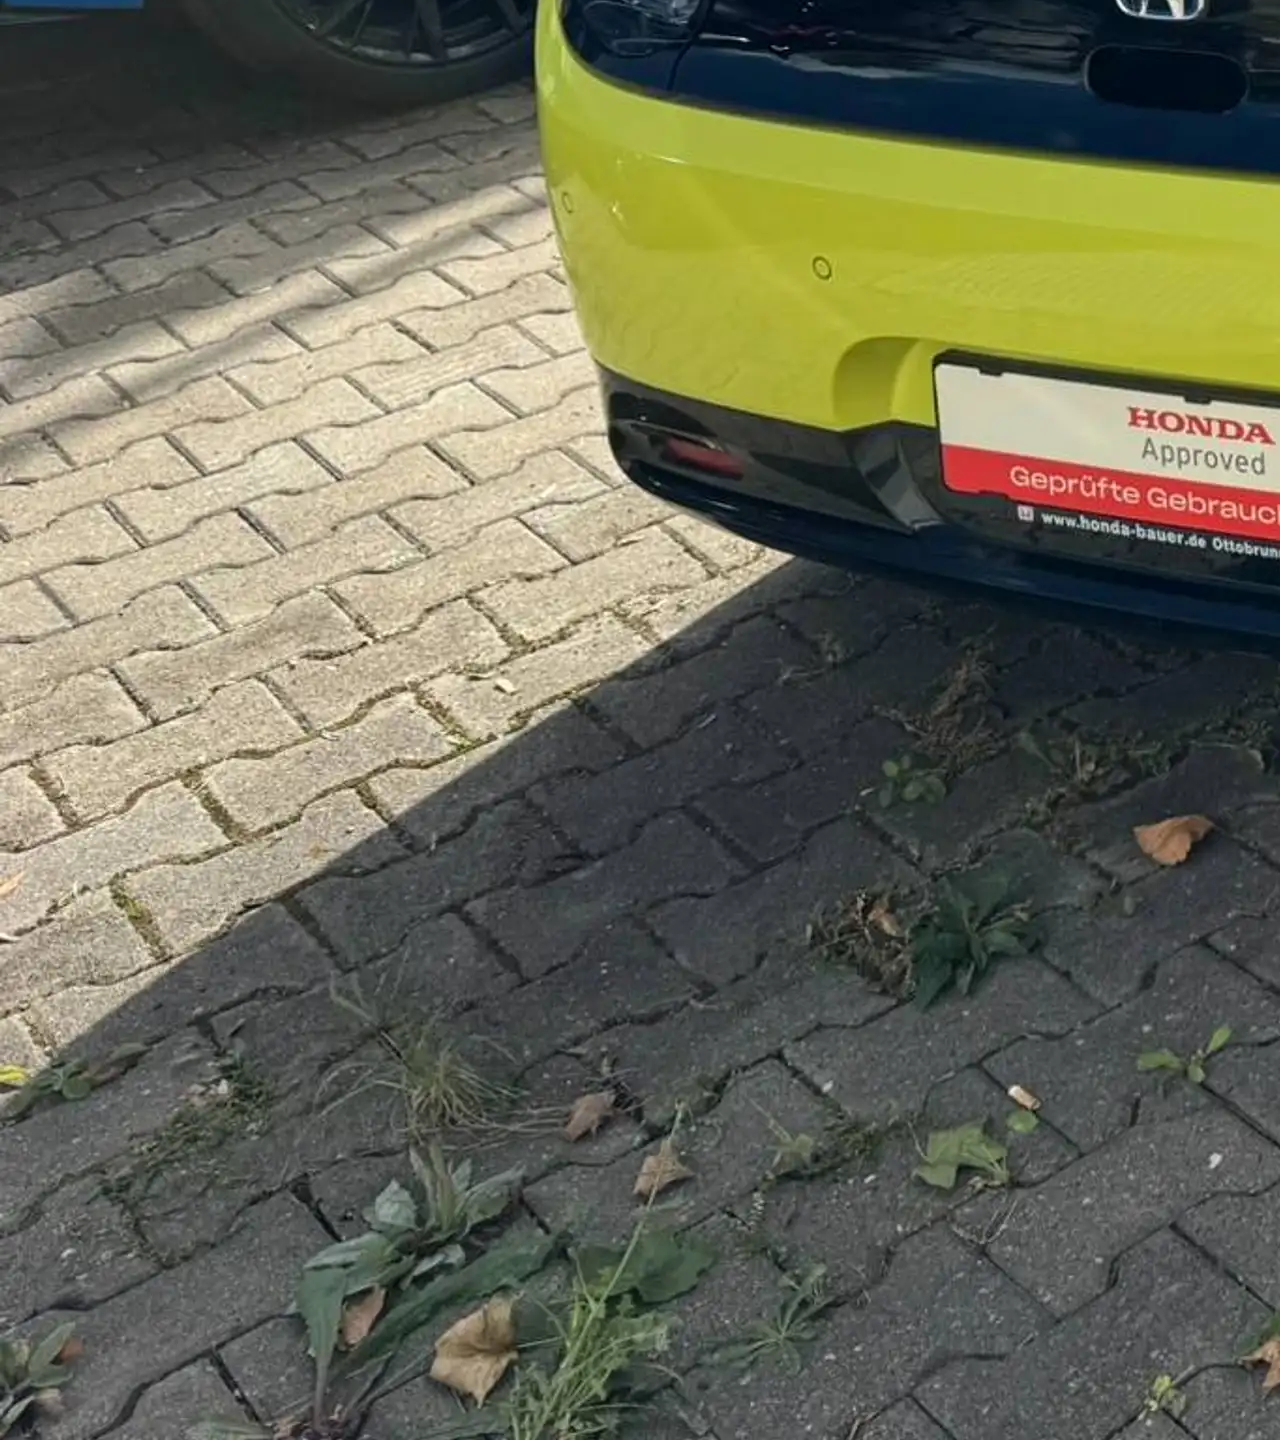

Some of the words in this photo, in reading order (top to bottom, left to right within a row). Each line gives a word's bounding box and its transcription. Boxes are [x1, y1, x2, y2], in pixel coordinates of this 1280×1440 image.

[1127, 406, 1276, 445] HONDA
[1142, 437, 1266, 475] Approved
[1010, 465, 1141, 505] Geprüfte
[1041, 511, 1207, 549] www.honda-bauer.de
